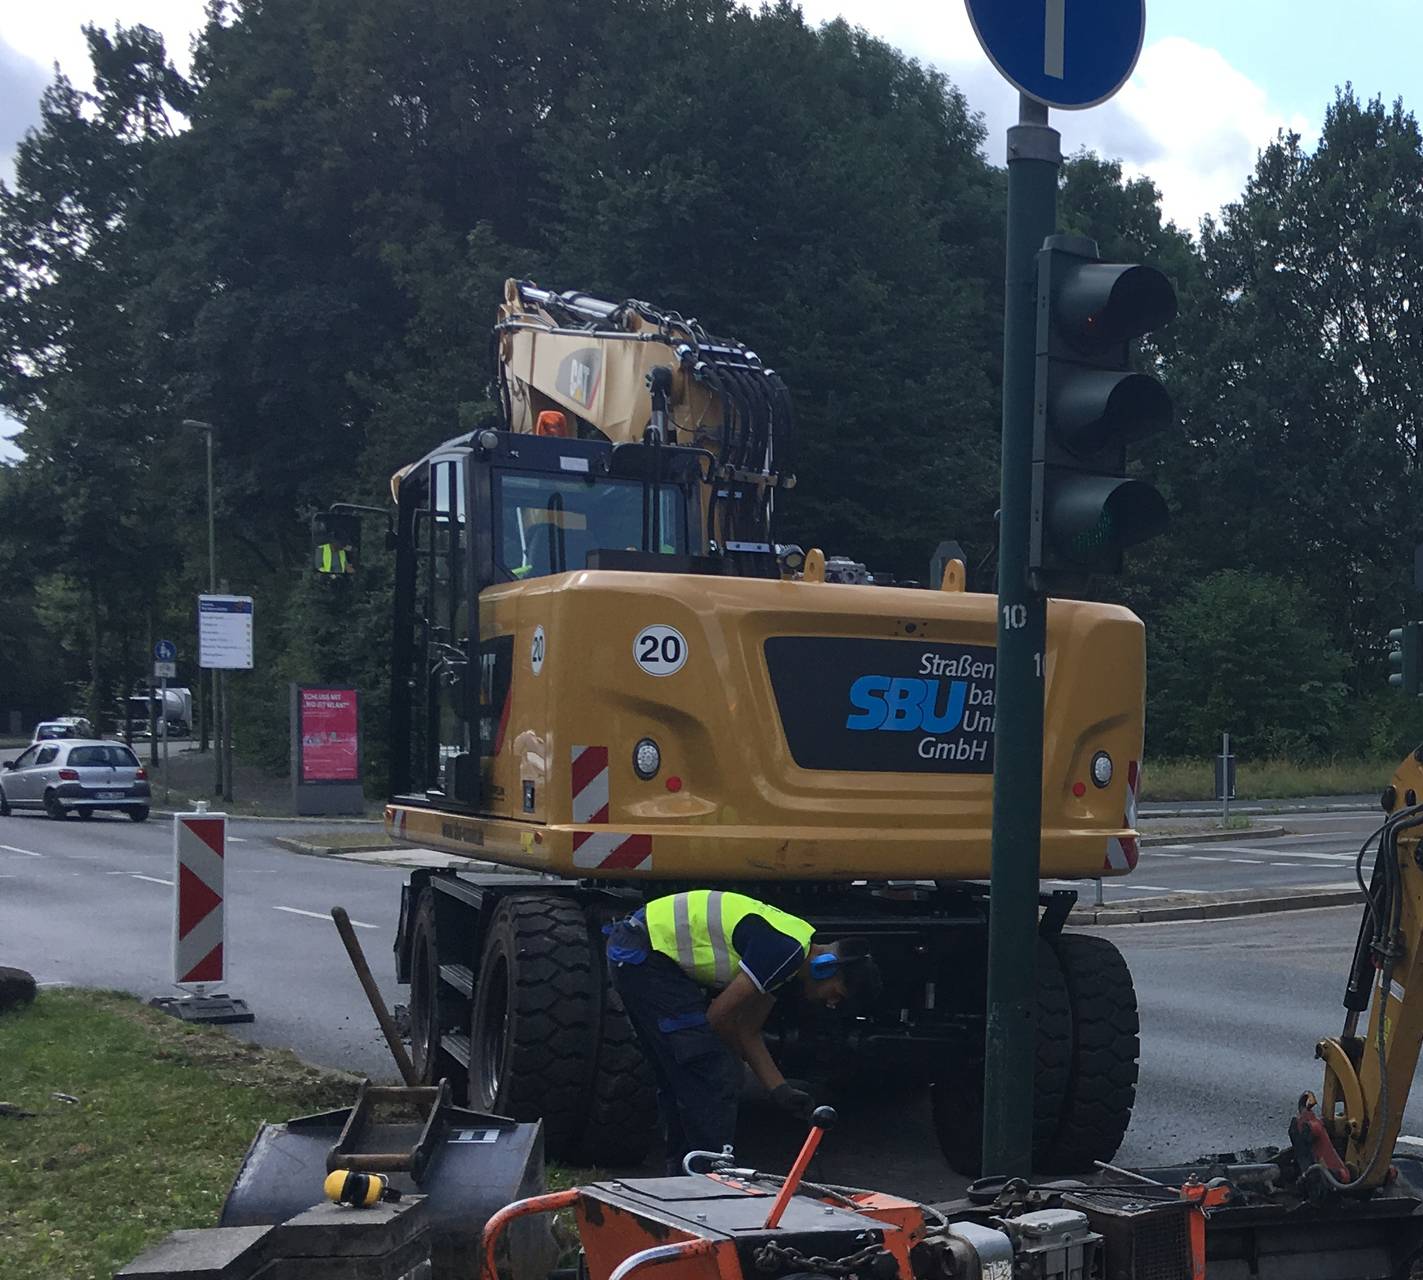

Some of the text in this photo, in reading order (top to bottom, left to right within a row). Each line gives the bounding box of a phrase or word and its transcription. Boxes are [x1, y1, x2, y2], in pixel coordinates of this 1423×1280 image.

[1002, 604, 1028, 630] 10
[532, 635, 544, 662] 20
[639, 635, 681, 663] 20
[918, 652, 995, 679] Straßen
[846, 675, 969, 734] SBU
[968, 682, 997, 706] ba
[917, 736, 988, 762] GmbH
